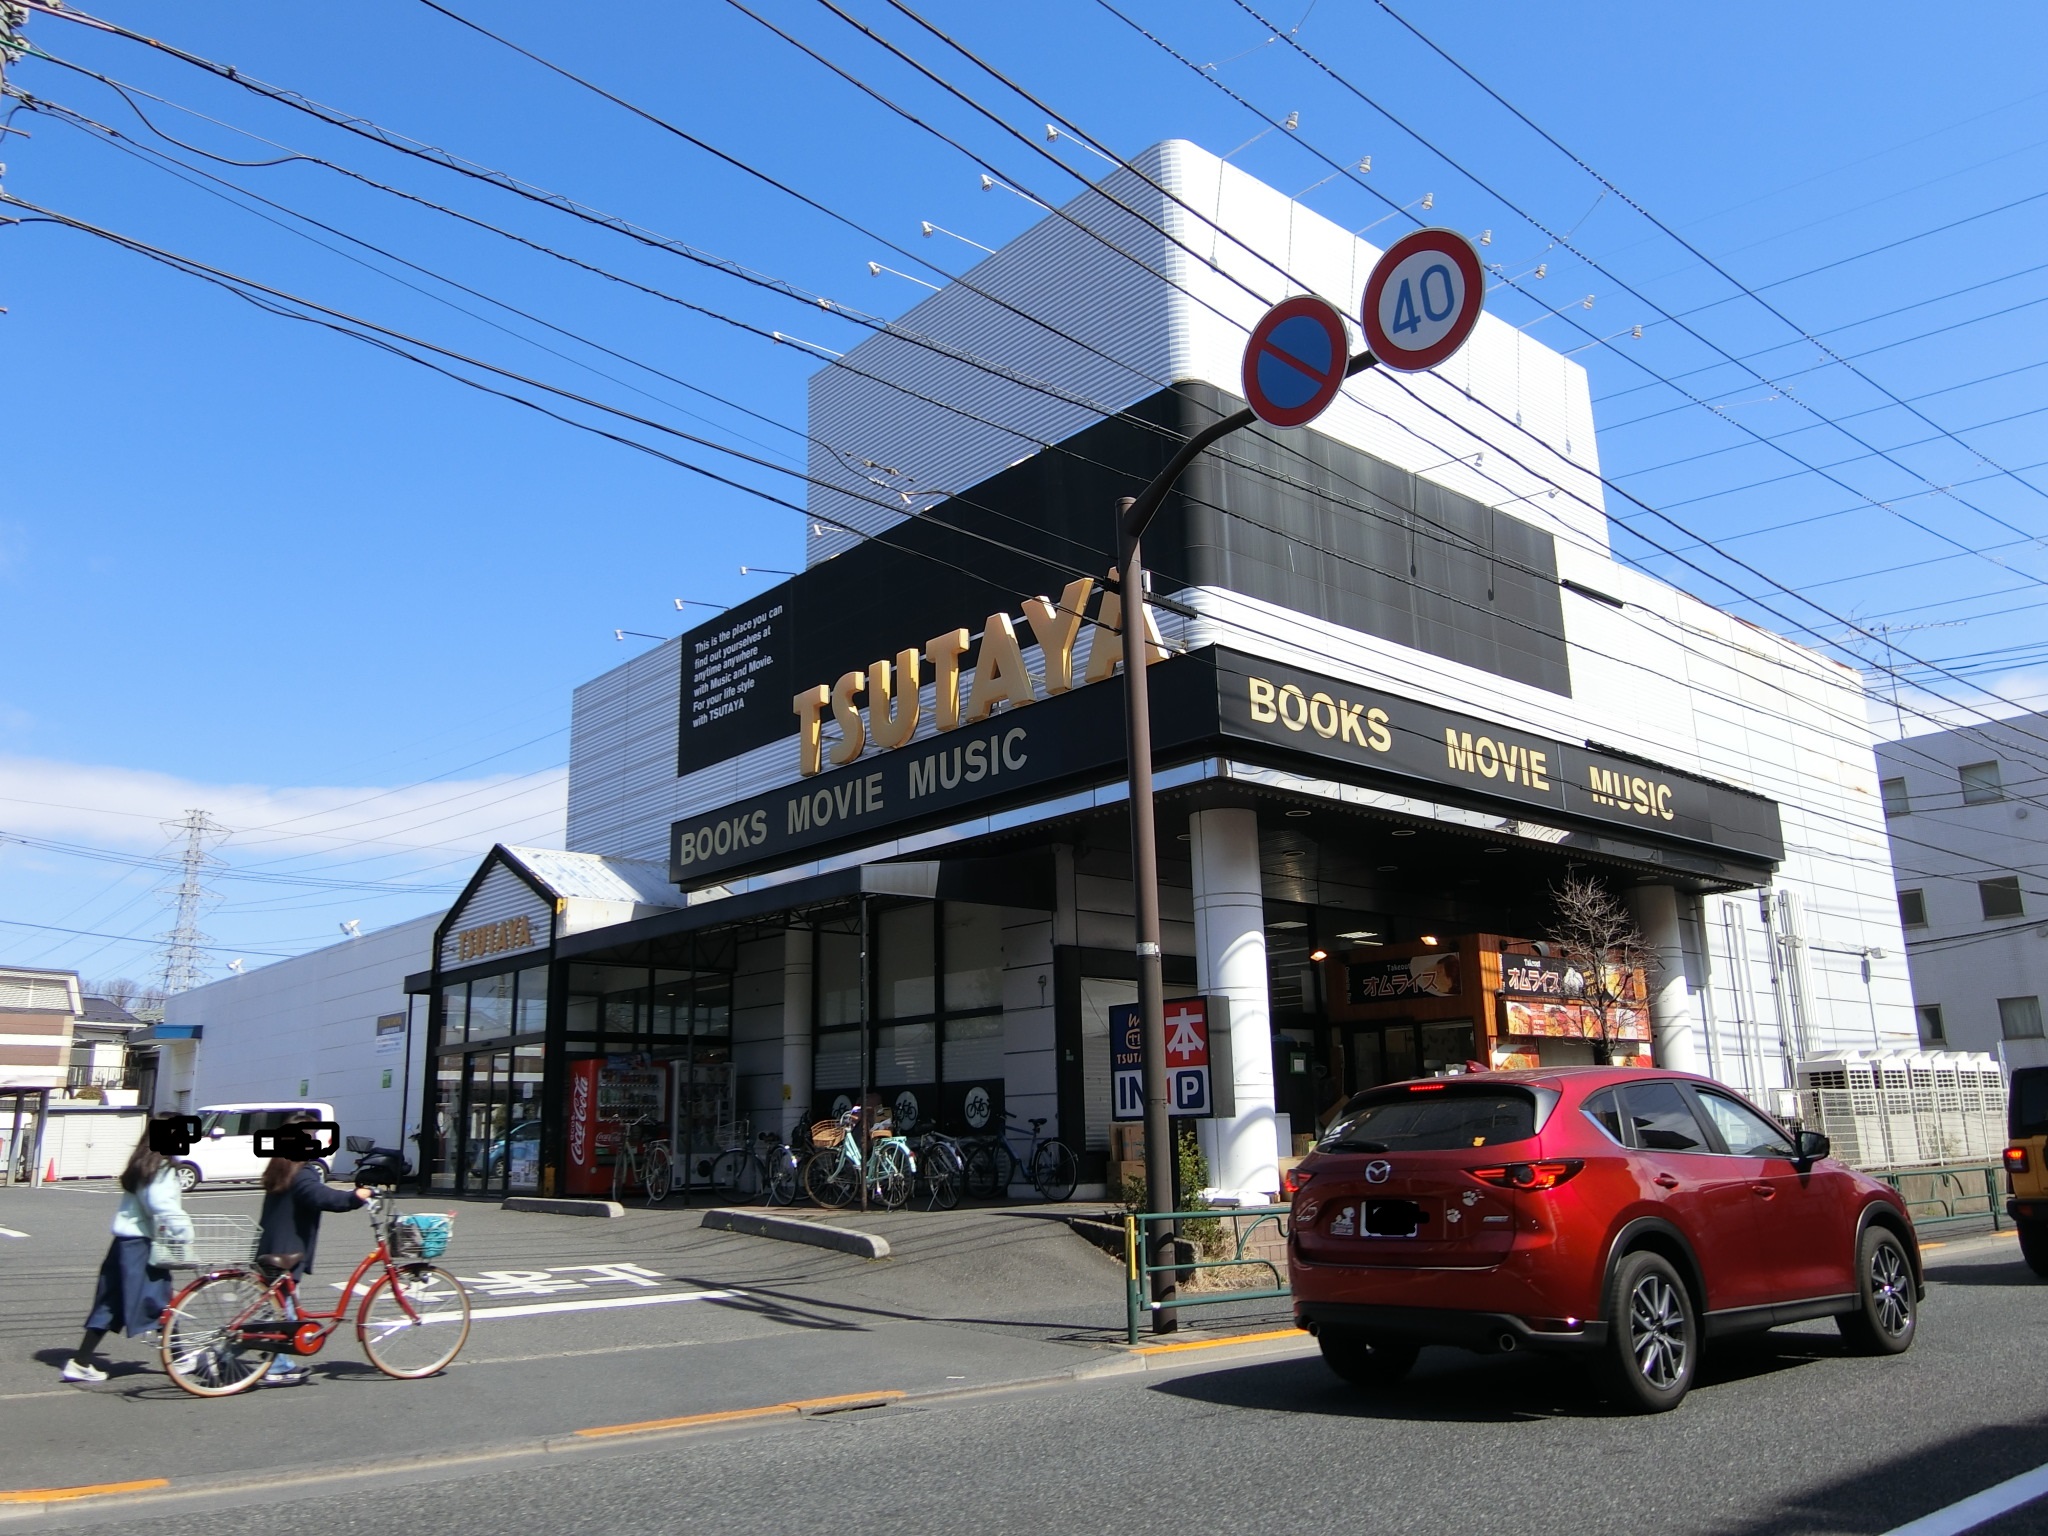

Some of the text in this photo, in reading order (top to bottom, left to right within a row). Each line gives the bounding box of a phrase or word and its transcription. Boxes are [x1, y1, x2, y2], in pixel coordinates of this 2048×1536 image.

[1392, 264, 1455, 335] 40
[694, 625, 771, 669] find out yourselves at
[695, 605, 783, 654] This is the place you can
[694, 646, 758, 683] anytime anywhere
[694, 655, 774, 698] with Music and Movie.
[793, 566, 1170, 777] TSUTAYA
[693, 678, 755, 712] For your life style
[693, 697, 745, 728] with TSUTAYA
[1248, 676, 1675, 822] BOOKS MOVIE MUSIC
[680, 727, 1028, 867] BOOKS MOVIE MUSIC
[458, 915, 532, 961] TSUTAYA
[1362, 971, 1440, 997] オムライス
[1507, 967, 1561, 993] オムライス
[1165, 1007, 1205, 1060] 本
[1116, 1052, 1142, 1064] TSUT
[1181, 1076, 1199, 1105] P
